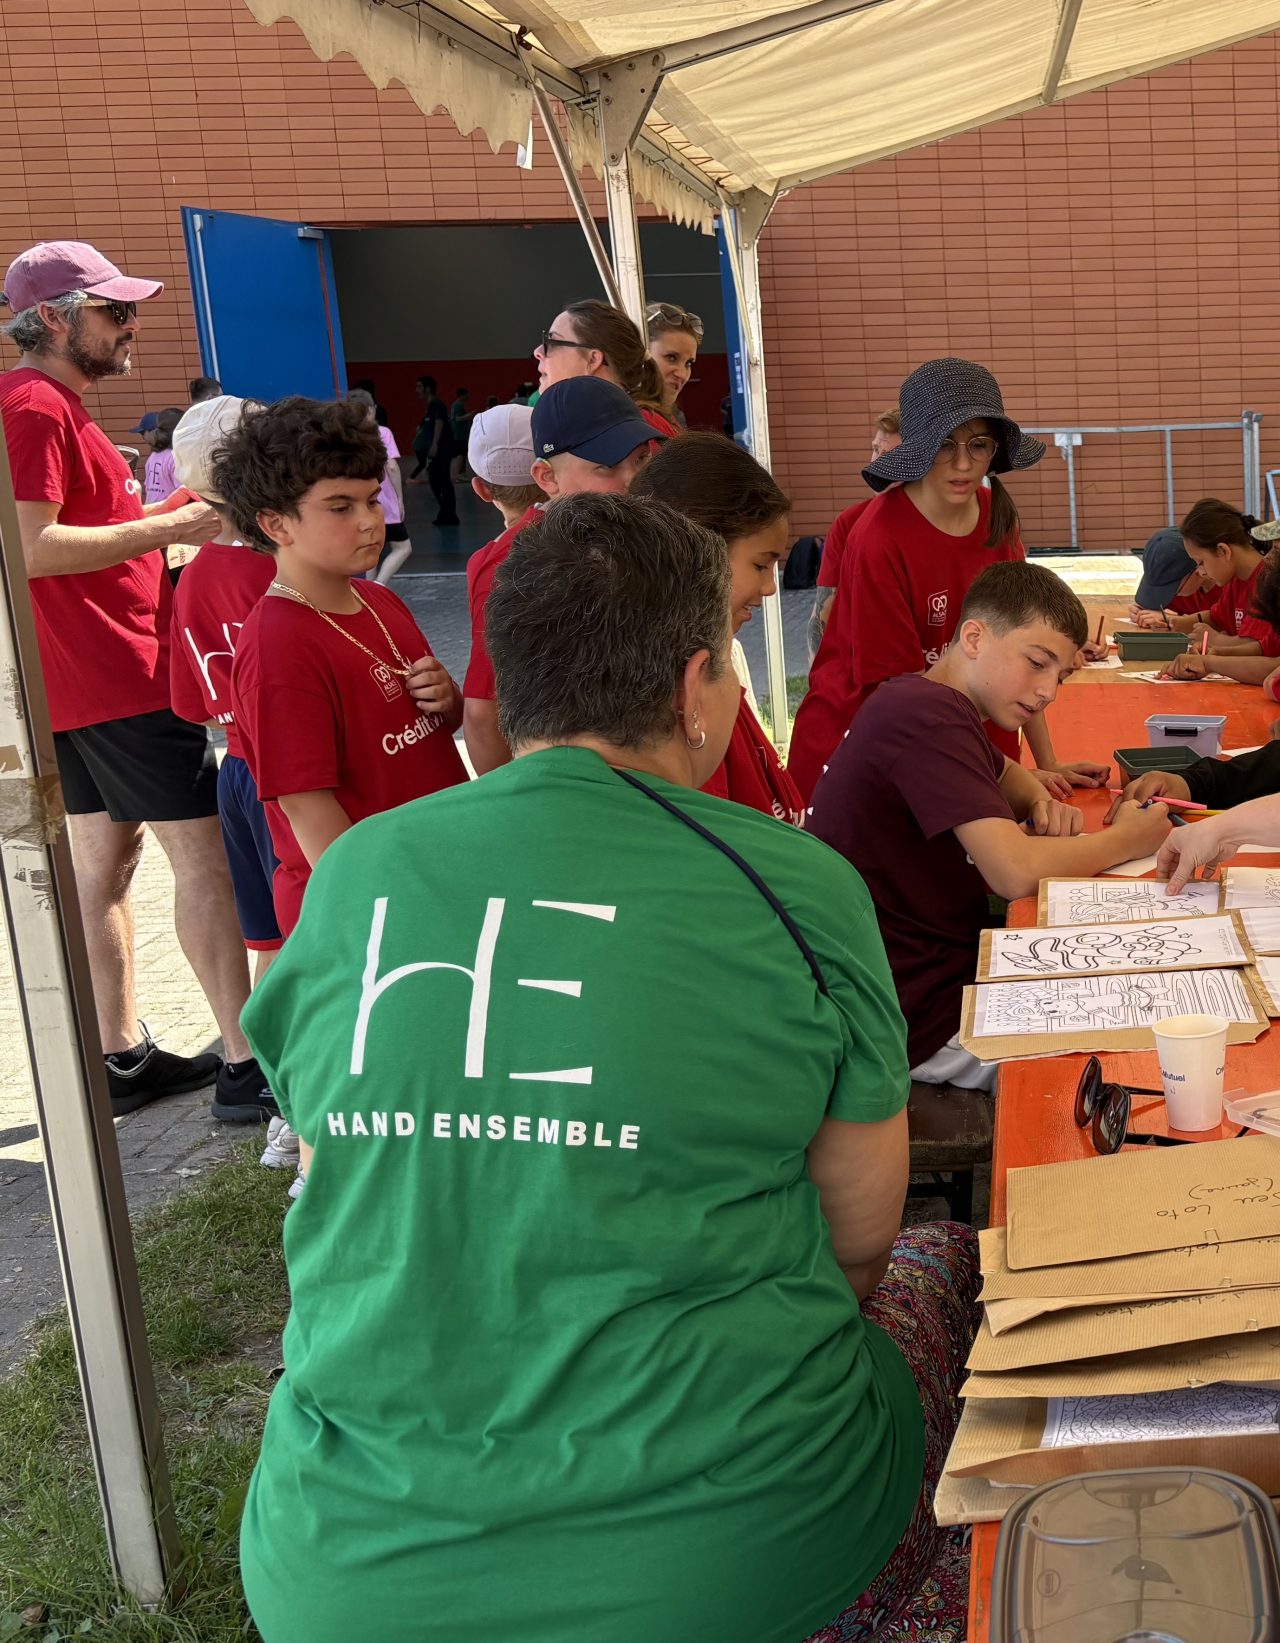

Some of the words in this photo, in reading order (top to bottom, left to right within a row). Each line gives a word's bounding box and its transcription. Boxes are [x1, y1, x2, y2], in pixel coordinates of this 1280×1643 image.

[382, 714, 434, 755] Crédit
[350, 897, 617, 1084] HE
[326, 1111, 416, 1137] HAND
[433, 1112, 641, 1150] ENSEMBLE
